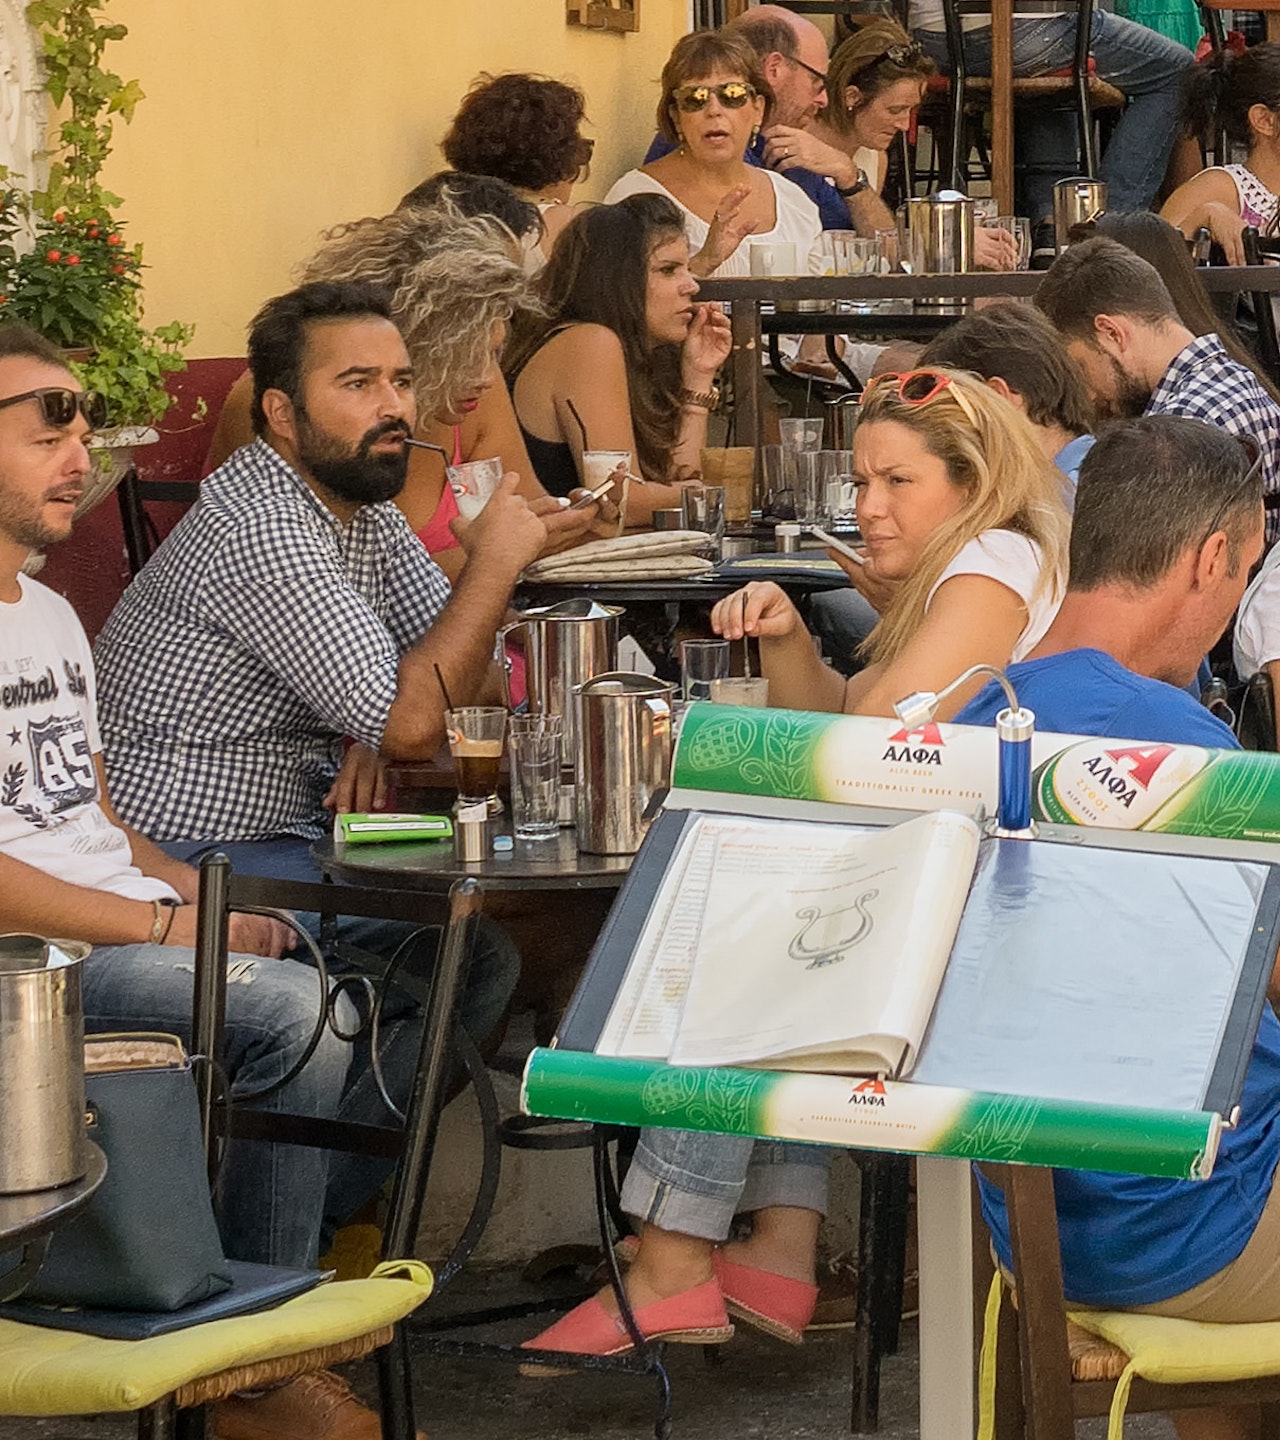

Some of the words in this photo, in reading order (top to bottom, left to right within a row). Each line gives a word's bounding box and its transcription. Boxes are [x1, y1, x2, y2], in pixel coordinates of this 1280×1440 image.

[0, 666, 59, 709] entral
[39, 731, 95, 793] 85
[881, 746, 943, 766] ΑΛΦΑ
[835, 778, 916, 794] TRADITIONALLY
[1082, 756, 1139, 809] ΑΛΦΑ
[848, 1094, 886, 1107] ΑΛΦΑ
